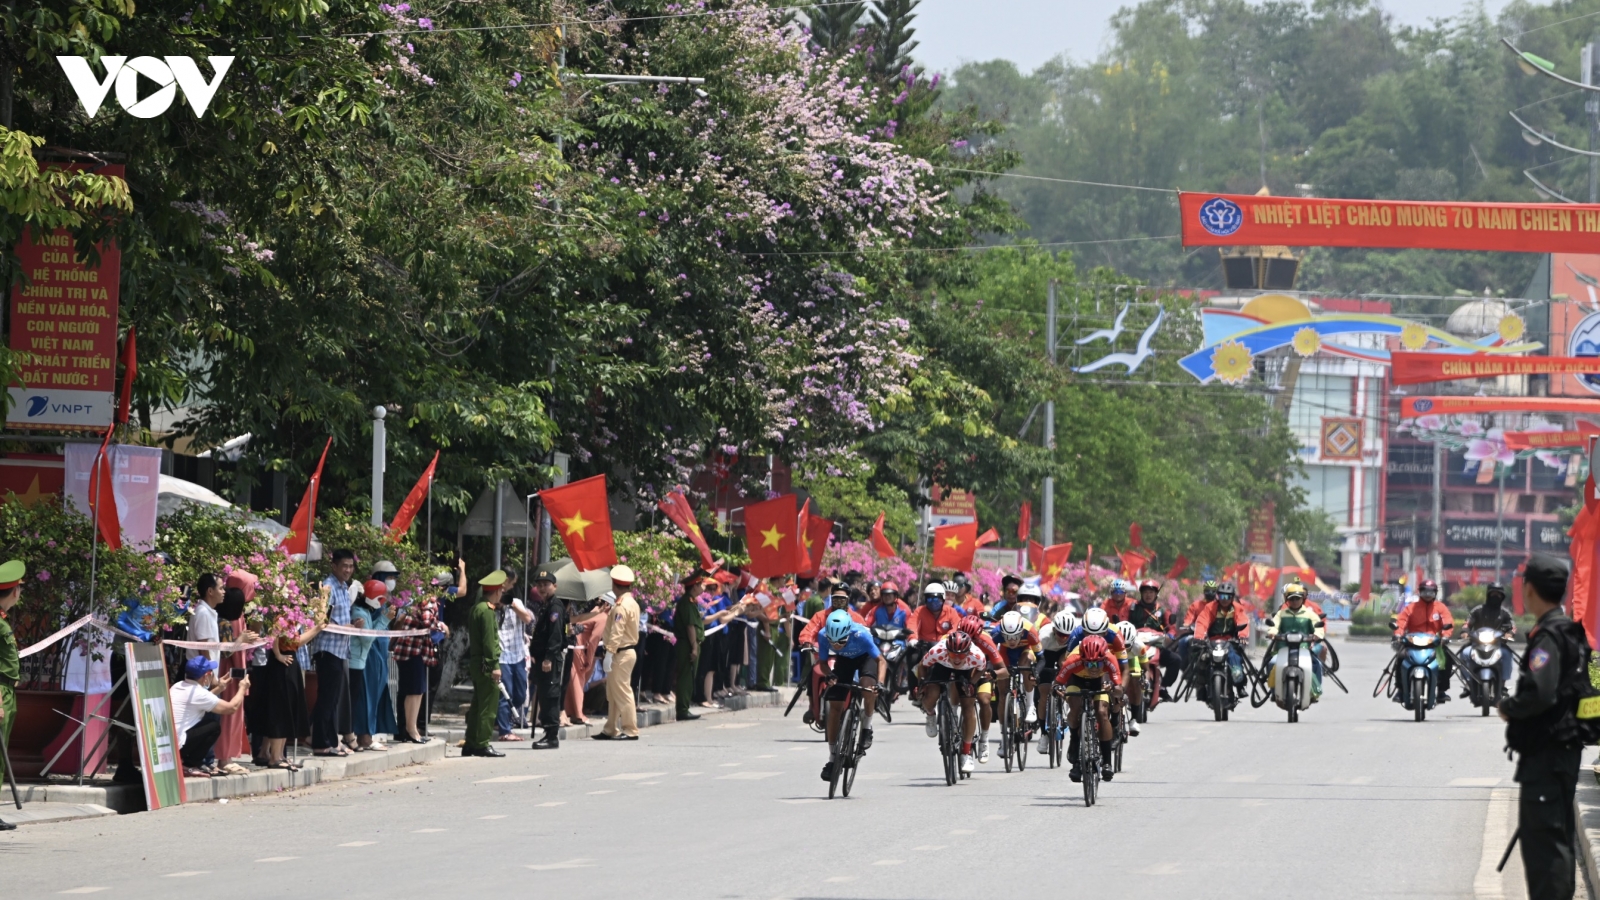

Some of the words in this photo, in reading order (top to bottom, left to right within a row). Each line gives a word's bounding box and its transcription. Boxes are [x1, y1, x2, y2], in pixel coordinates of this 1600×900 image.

[1253, 200, 1302, 228] NHIỆT
[1307, 201, 1341, 228] LIỆT
[1346, 202, 1392, 227] CHÀO
[1451, 207, 1473, 229] 70
[42, 249, 69, 264] CỦA
[33, 266, 50, 283] HỆ
[54, 266, 98, 283] THỐNG
[22, 284, 62, 298] CHÍNH
[66, 287, 87, 301] TRỊ
[91, 286, 108, 300] VÀ
[49, 302, 76, 316] VĂN
[80, 303, 111, 319] HÓA,
[27, 320, 54, 332] CON
[58, 320, 100, 334] NGƯỜI
[30, 335, 59, 352] VIỆT
[62, 339, 94, 351] NAM
[72, 353, 111, 369] TRIỂN
[23, 368, 49, 384] ĐẤT
[52, 371, 89, 386] NƯỚC
[52, 403, 93, 415] VNPT
